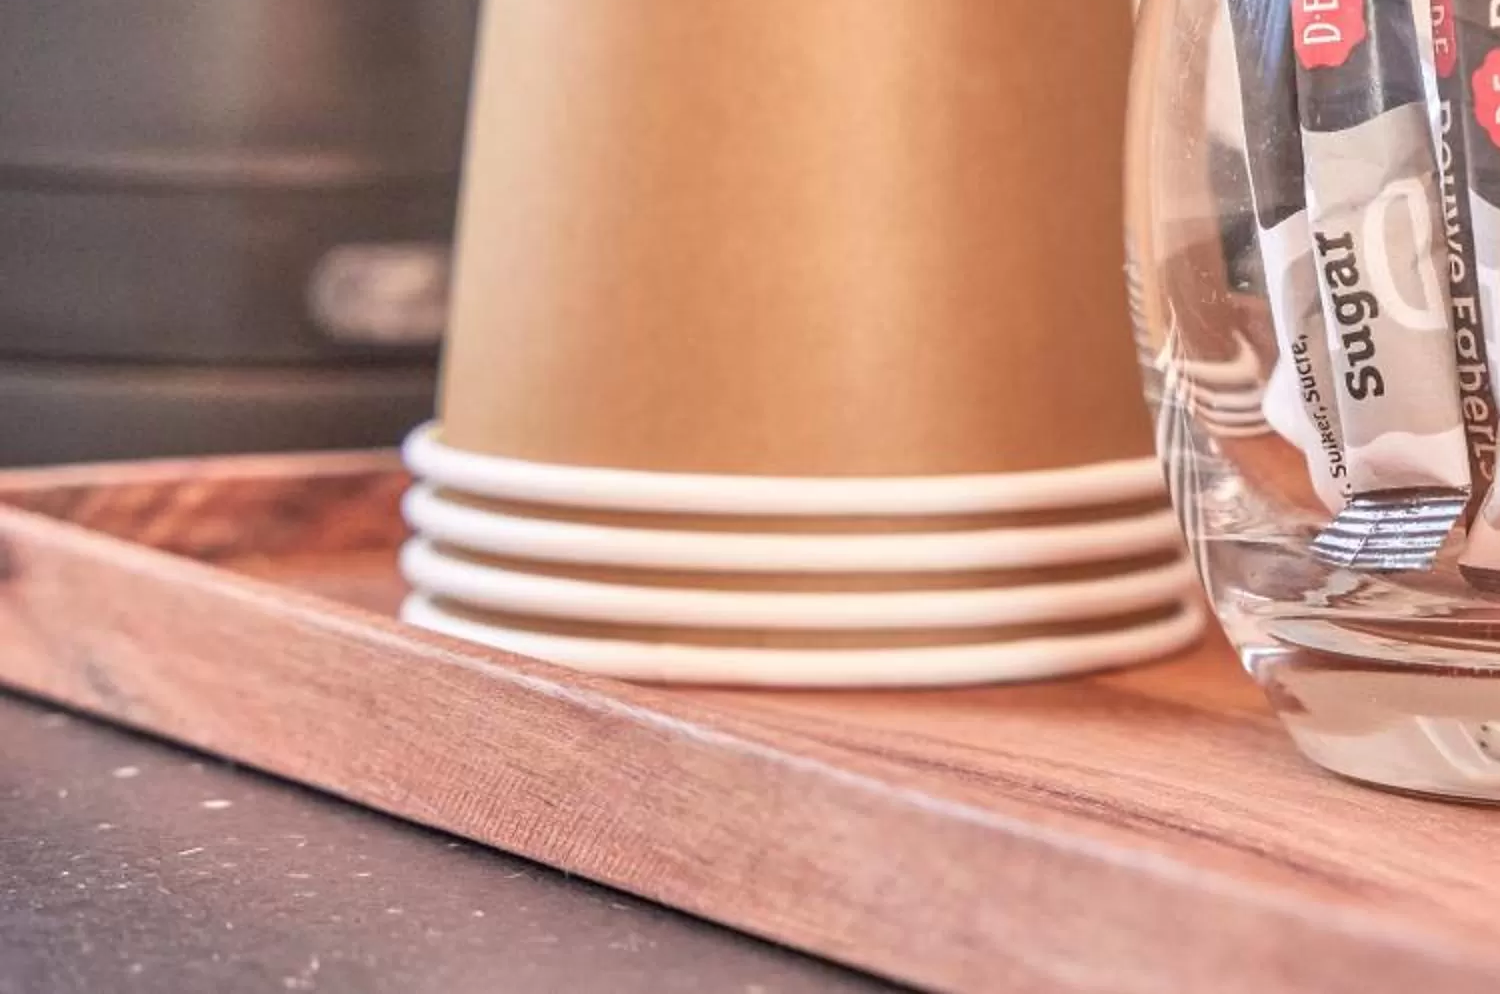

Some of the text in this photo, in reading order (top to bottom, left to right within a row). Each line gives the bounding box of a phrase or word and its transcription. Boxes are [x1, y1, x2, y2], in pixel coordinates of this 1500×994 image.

[1314, 231, 1385, 401] Sugar
[1291, 333, 1321, 403] Sucre,
[1315, 405, 1348, 478] Suiker,
